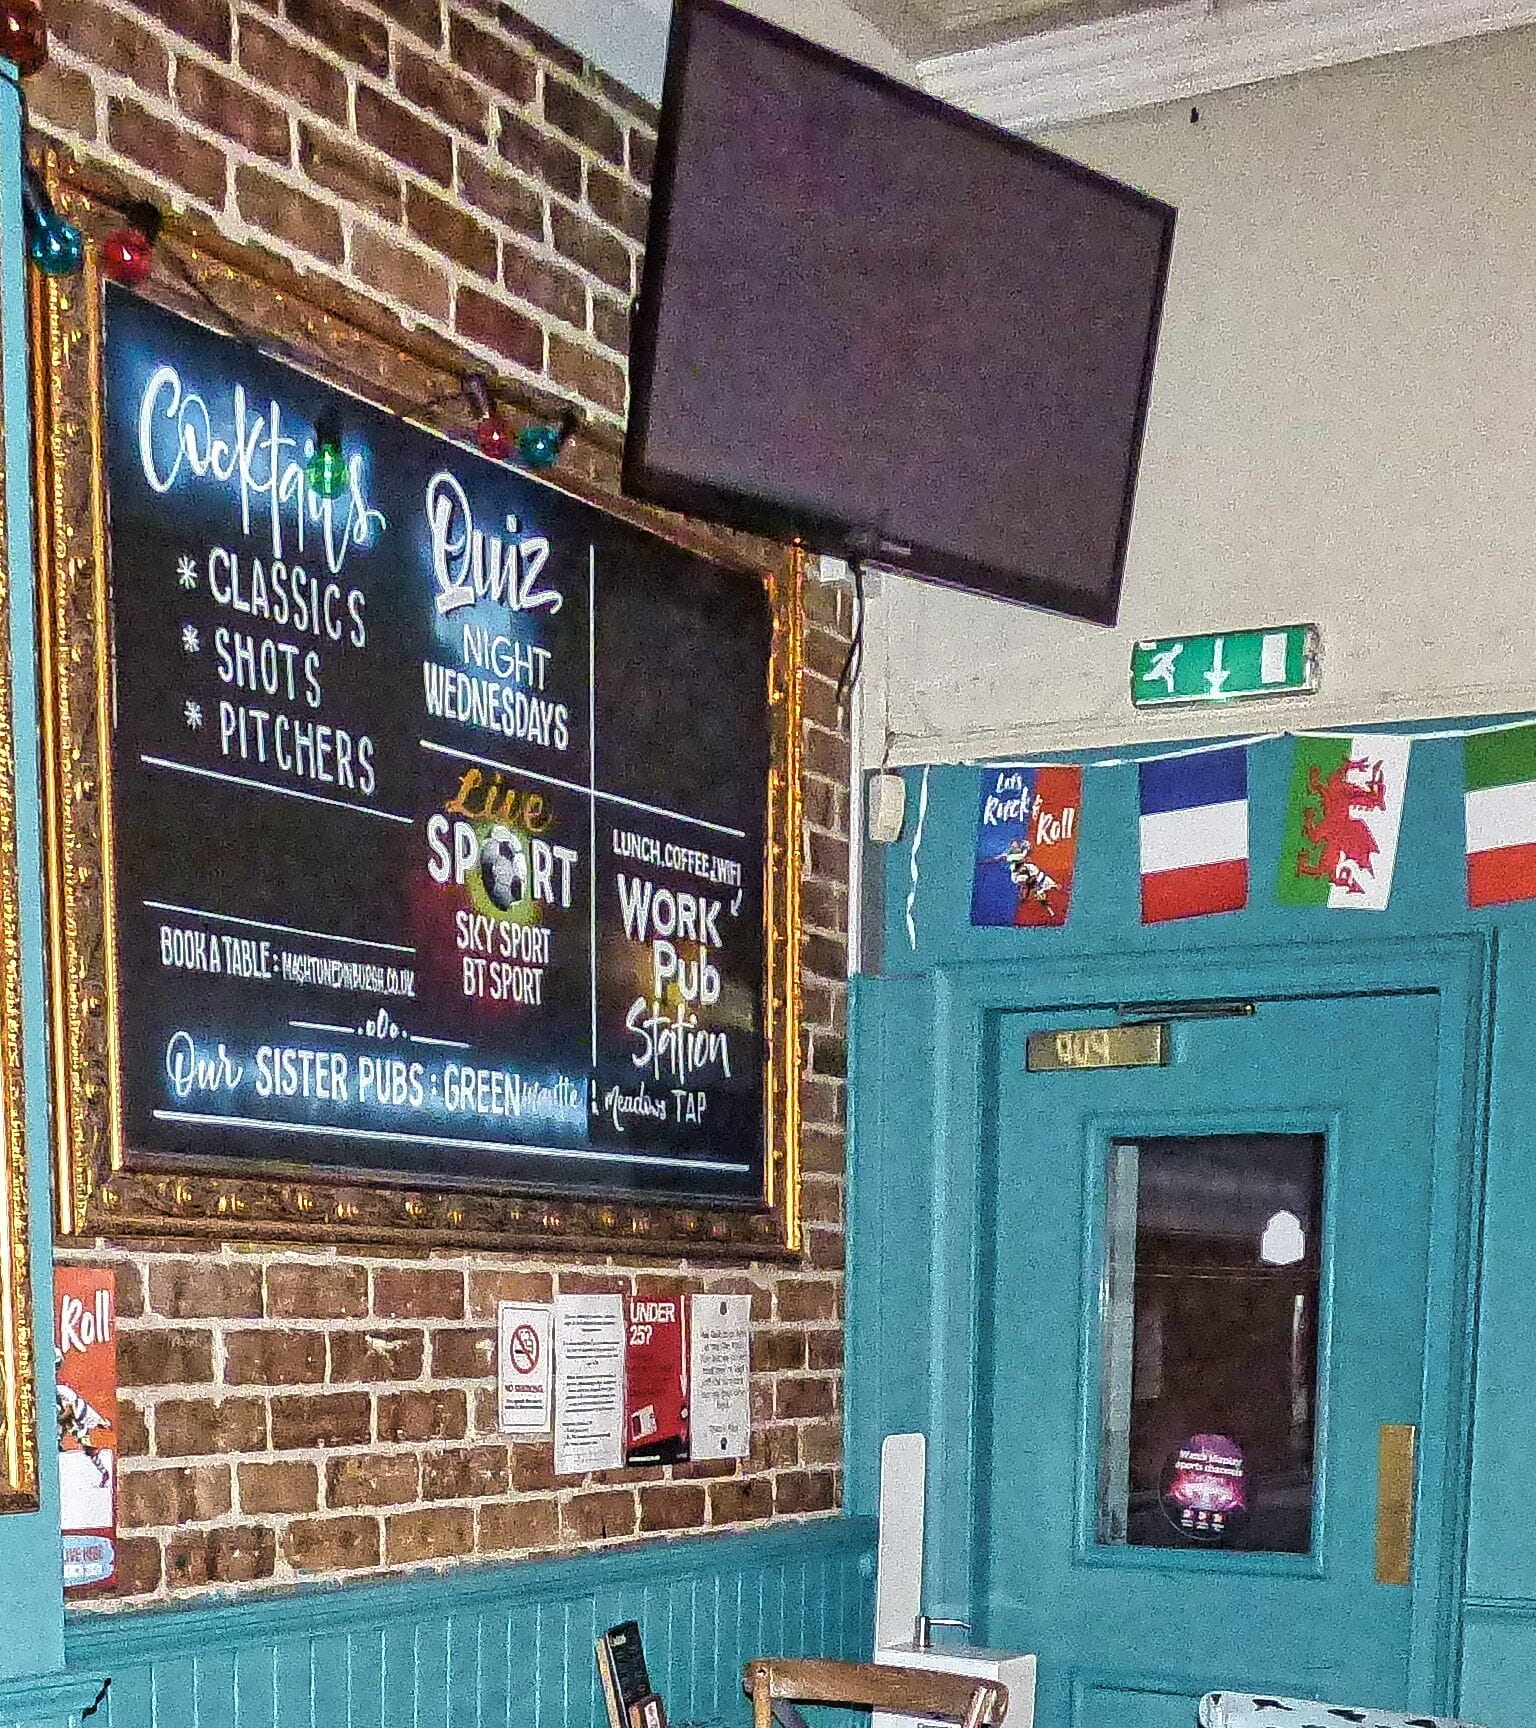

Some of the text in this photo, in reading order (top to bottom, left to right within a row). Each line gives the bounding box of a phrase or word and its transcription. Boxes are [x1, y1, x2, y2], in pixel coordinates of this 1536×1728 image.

[139, 365, 386, 573] Cocktails
[426, 470, 563, 615] Quiz
[208, 546, 366, 648] CLASSICS
[215, 627, 321, 709] SHOTS
[463, 623, 552, 691] NIGHT
[423, 660, 569, 751] WEDNESDAYS
[219, 700, 376, 796] PITCHERS
[445, 768, 554, 833] Live
[1036, 807, 1075, 846] Roll
[455, 910, 551, 965] SKY SPORT
[617, 873, 723, 948] WORK
[160, 925, 208, 972] BOOK
[209, 934, 222, 973] A
[463, 956, 544, 1006] BT SPORT
[652, 939, 721, 1006] Pub
[626, 996, 732, 1085] Station
[166, 1030, 244, 1098] Our
[255, 1044, 348, 1101] SISTER
[604, 1081, 667, 1132] Meadows
[671, 1088, 708, 1125] TAP
[60, 1290, 110, 1354] Roll
[630, 1302, 676, 1323] UNDER
[630, 1324, 654, 1346] 25?
